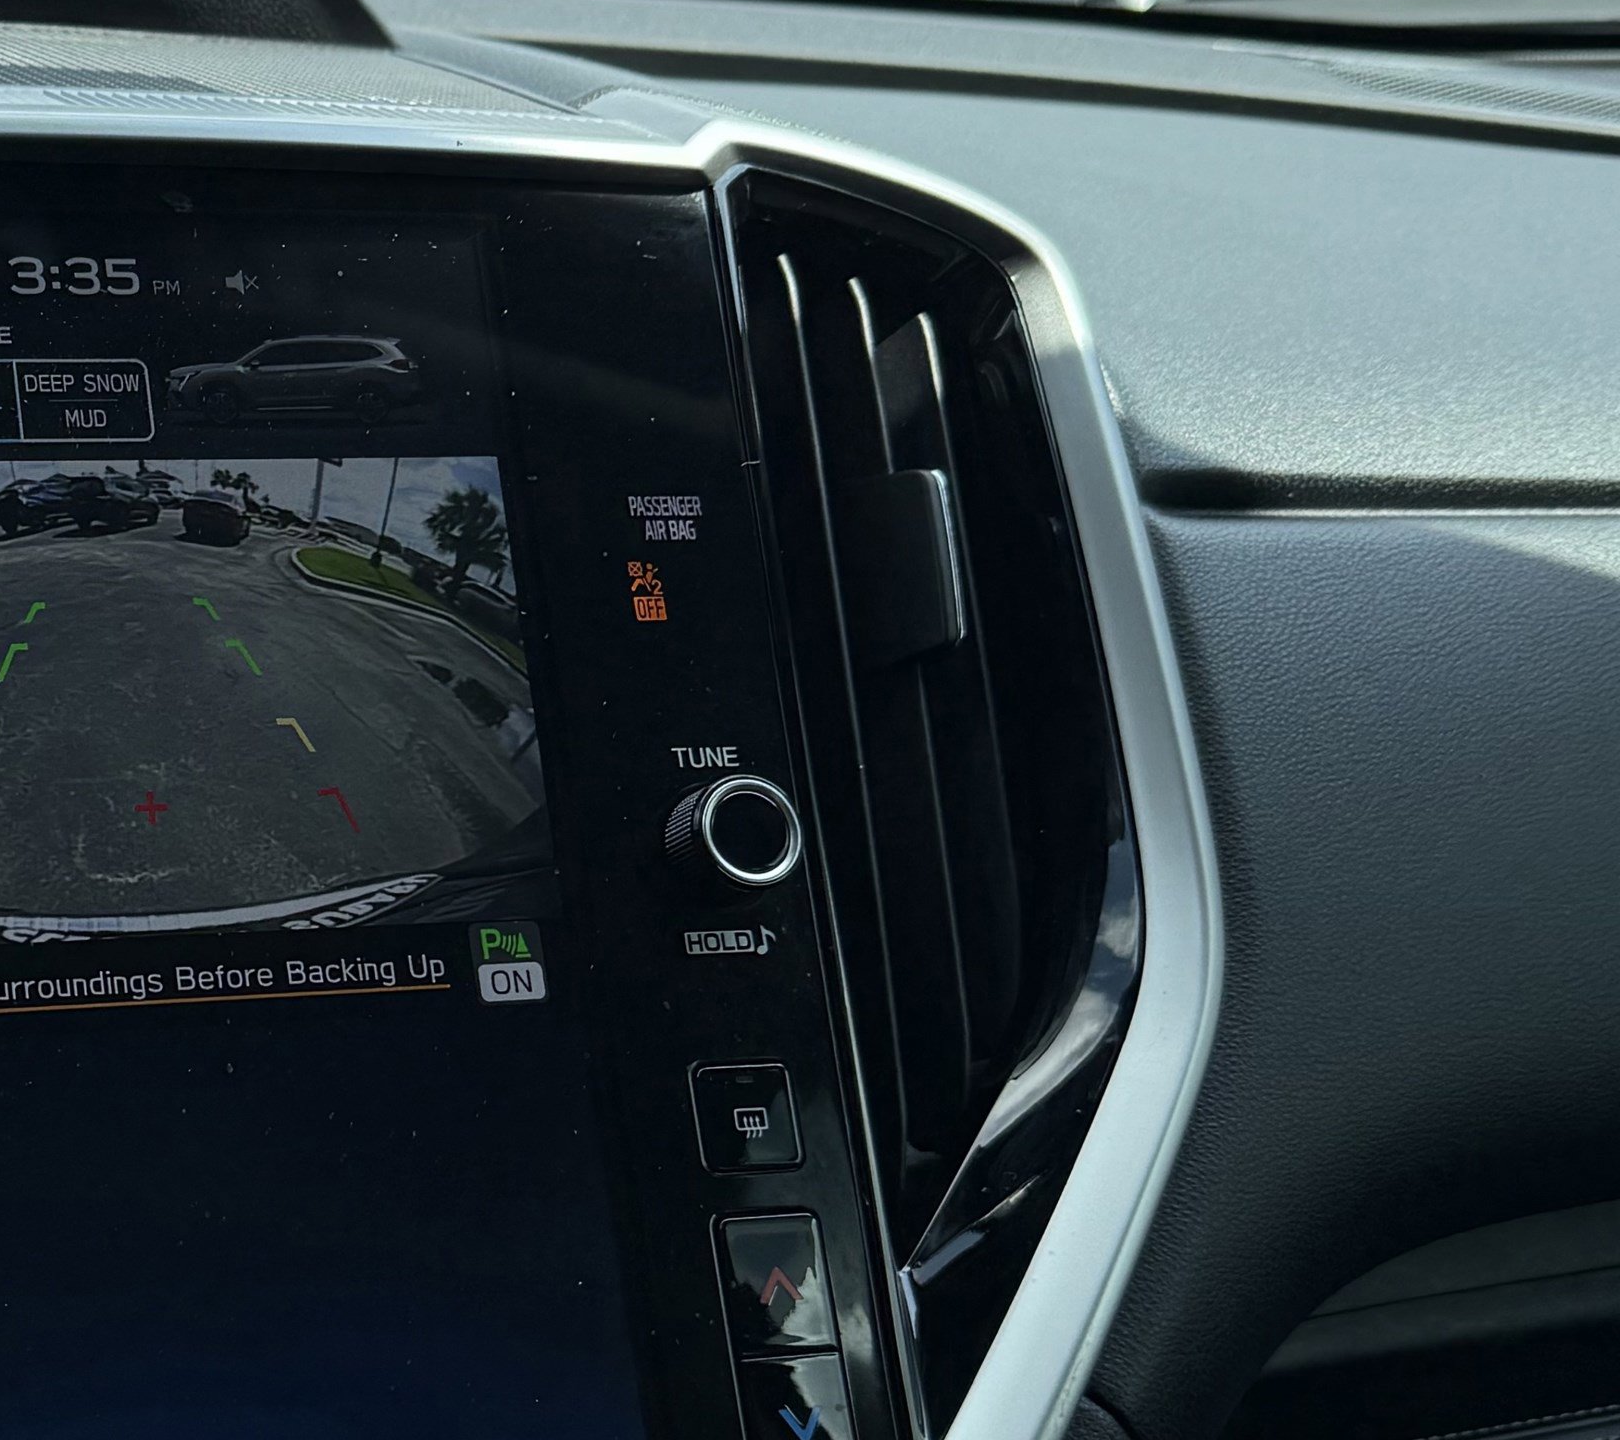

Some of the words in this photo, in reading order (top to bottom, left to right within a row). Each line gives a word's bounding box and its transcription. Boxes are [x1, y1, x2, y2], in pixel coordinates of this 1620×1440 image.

[7, 255, 140, 295] 3:35
[152, 279, 181, 296] PM
[23, 374, 75, 393] DEEP
[83, 373, 139, 393] SNOW
[64, 409, 107, 428] MUD
[627, 495, 703, 517] PASSENGER
[645, 519, 667, 541] AIR
[668, 519, 697, 541] BAG
[636, 598, 664, 619] OFF
[670, 746, 740, 769] TUNE
[687, 932, 752, 953] HOLD
[175, 964, 276, 994] Before
[286, 958, 399, 992] Backing
[407, 953, 445, 984] Up
[490, 969, 533, 995] ON
